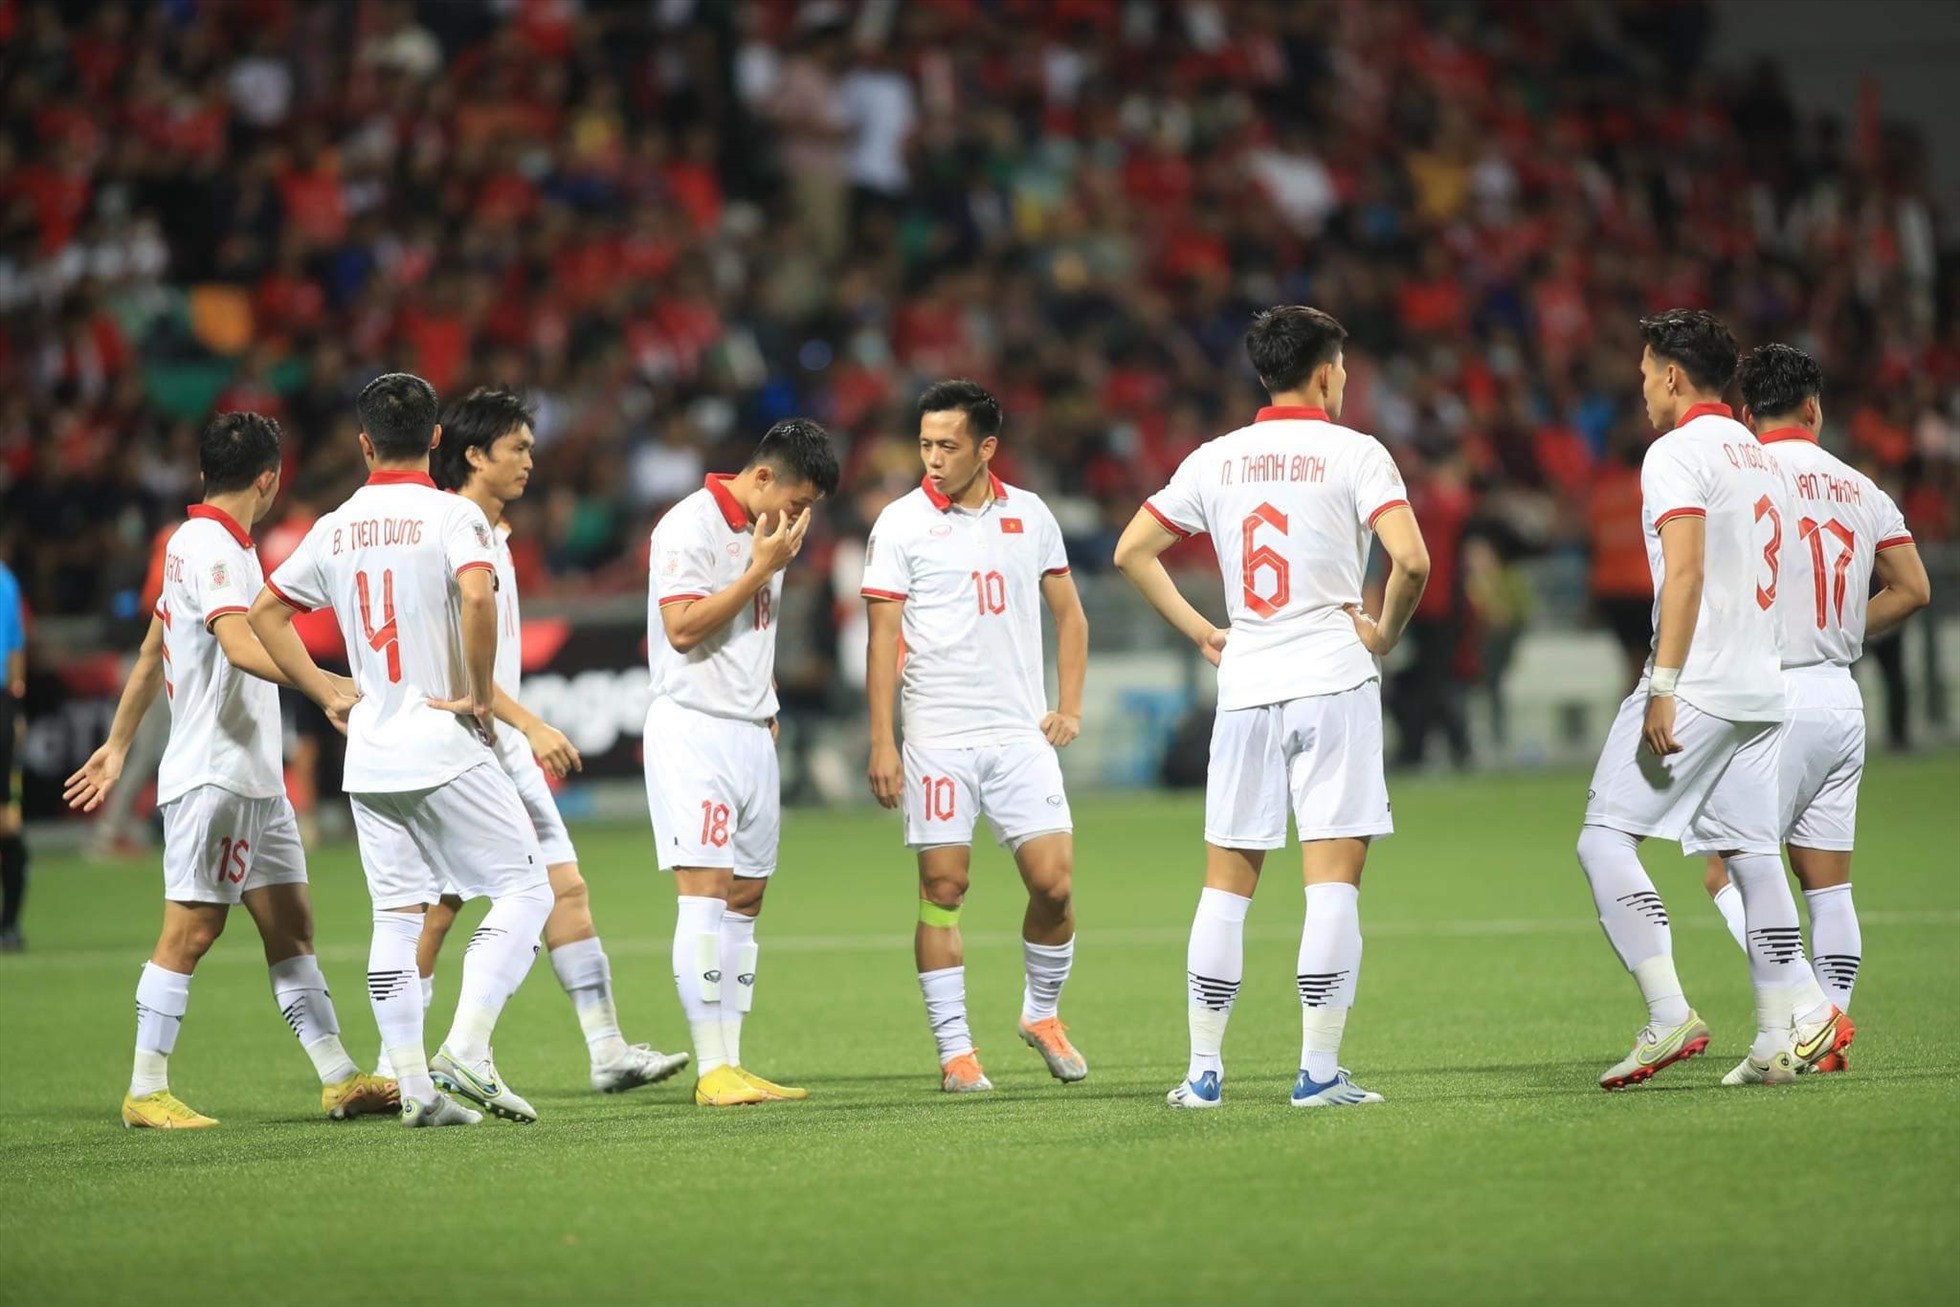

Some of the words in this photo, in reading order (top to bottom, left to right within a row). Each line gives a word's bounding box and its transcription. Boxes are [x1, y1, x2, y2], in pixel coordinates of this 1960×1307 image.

[1221, 460, 1233, 486] N.
[1242, 454, 1286, 484] THANH
[1290, 455, 1326, 483] BINH
[1821, 473, 1861, 506] THANH
[333, 528, 344, 556] B.
[350, 518, 379, 551] TIEN
[383, 518, 424, 546] DUNG
[1242, 502, 1290, 619] 6
[1754, 494, 1782, 611] 3
[972, 570, 1006, 616] 10
[1798, 516, 1855, 631] 17
[355, 569, 402, 684] 4
[922, 775, 956, 822] 10
[701, 800, 730, 848] 18
[219, 836, 249, 885] 15
